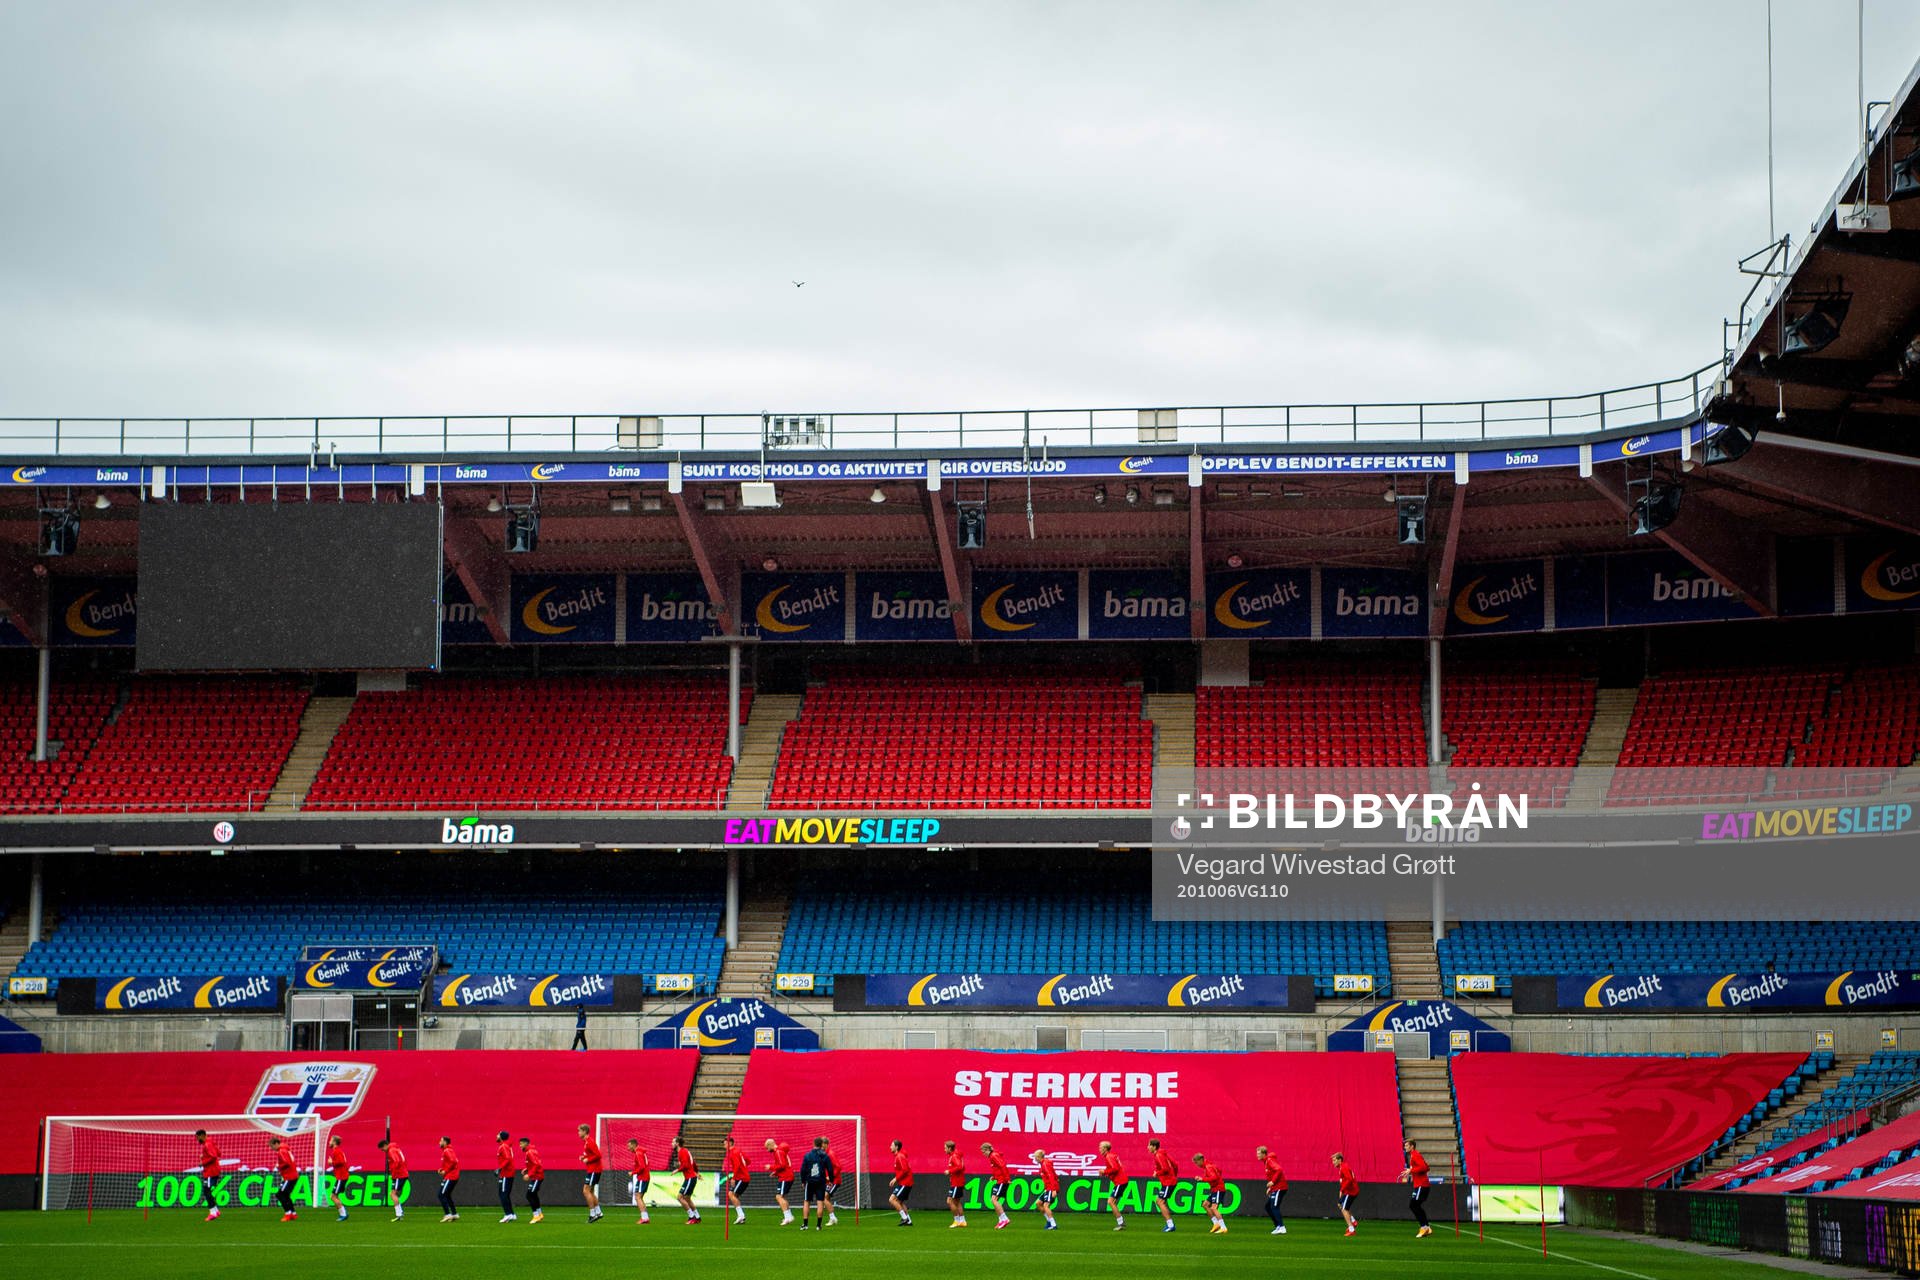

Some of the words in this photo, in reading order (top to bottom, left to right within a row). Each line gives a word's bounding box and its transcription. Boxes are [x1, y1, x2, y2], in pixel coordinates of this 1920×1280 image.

[21, 466, 46, 478] Bendit
[540, 464, 564, 476] Bendit
[683, 465, 725, 476] SUNT
[730, 464, 814, 476] KOSTHOLD
[818, 464, 841, 475] OG
[845, 463, 925, 475] AKTIVITET
[941, 462, 968, 473] GIR
[970, 461, 1066, 473] OVERSKUDD
[1128, 456, 1153, 468] Bendit
[1201, 457, 1272, 470] OPPLEV
[1276, 456, 1447, 469] BENDIT-EFFEKTEN
[1886, 563, 1920, 586] Ben
[545, 587, 606, 621] Bendit
[778, 586, 839, 620] Bendit
[1004, 584, 1065, 618] Bendit
[1104, 590, 1185, 617] bama
[1237, 581, 1300, 616] Bendit
[1336, 588, 1419, 616] bama
[1476, 573, 1537, 611] Bendit
[89, 593, 137, 623] Bend
[442, 818, 514, 843] bama
[318, 962, 349, 980] Bendit
[380, 962, 411, 980] Bendit
[660, 980, 678, 988] 228
[792, 979, 810, 988] 229
[1338, 980, 1355, 989] 231
[1473, 980, 1489, 989] 231
[126, 976, 182, 1008] Bendit
[215, 975, 271, 1007] Bendit
[461, 974, 517, 1005] Bendit
[549, 974, 605, 1005] Bendit
[928, 974, 985, 1005] Bendit
[1058, 974, 1114, 1005] Bendit
[1188, 975, 1245, 1006] Bendit
[1606, 974, 1663, 1007] Bendit
[1728, 973, 1784, 1006] Bendit
[1845, 970, 1900, 1005] Bendit
[705, 1000, 765, 1034] Bendit
[1392, 1003, 1453, 1032] Bendit
[953, 1070, 1179, 1099] STERKERE
[961, 1103, 1167, 1134] SAMMEN
